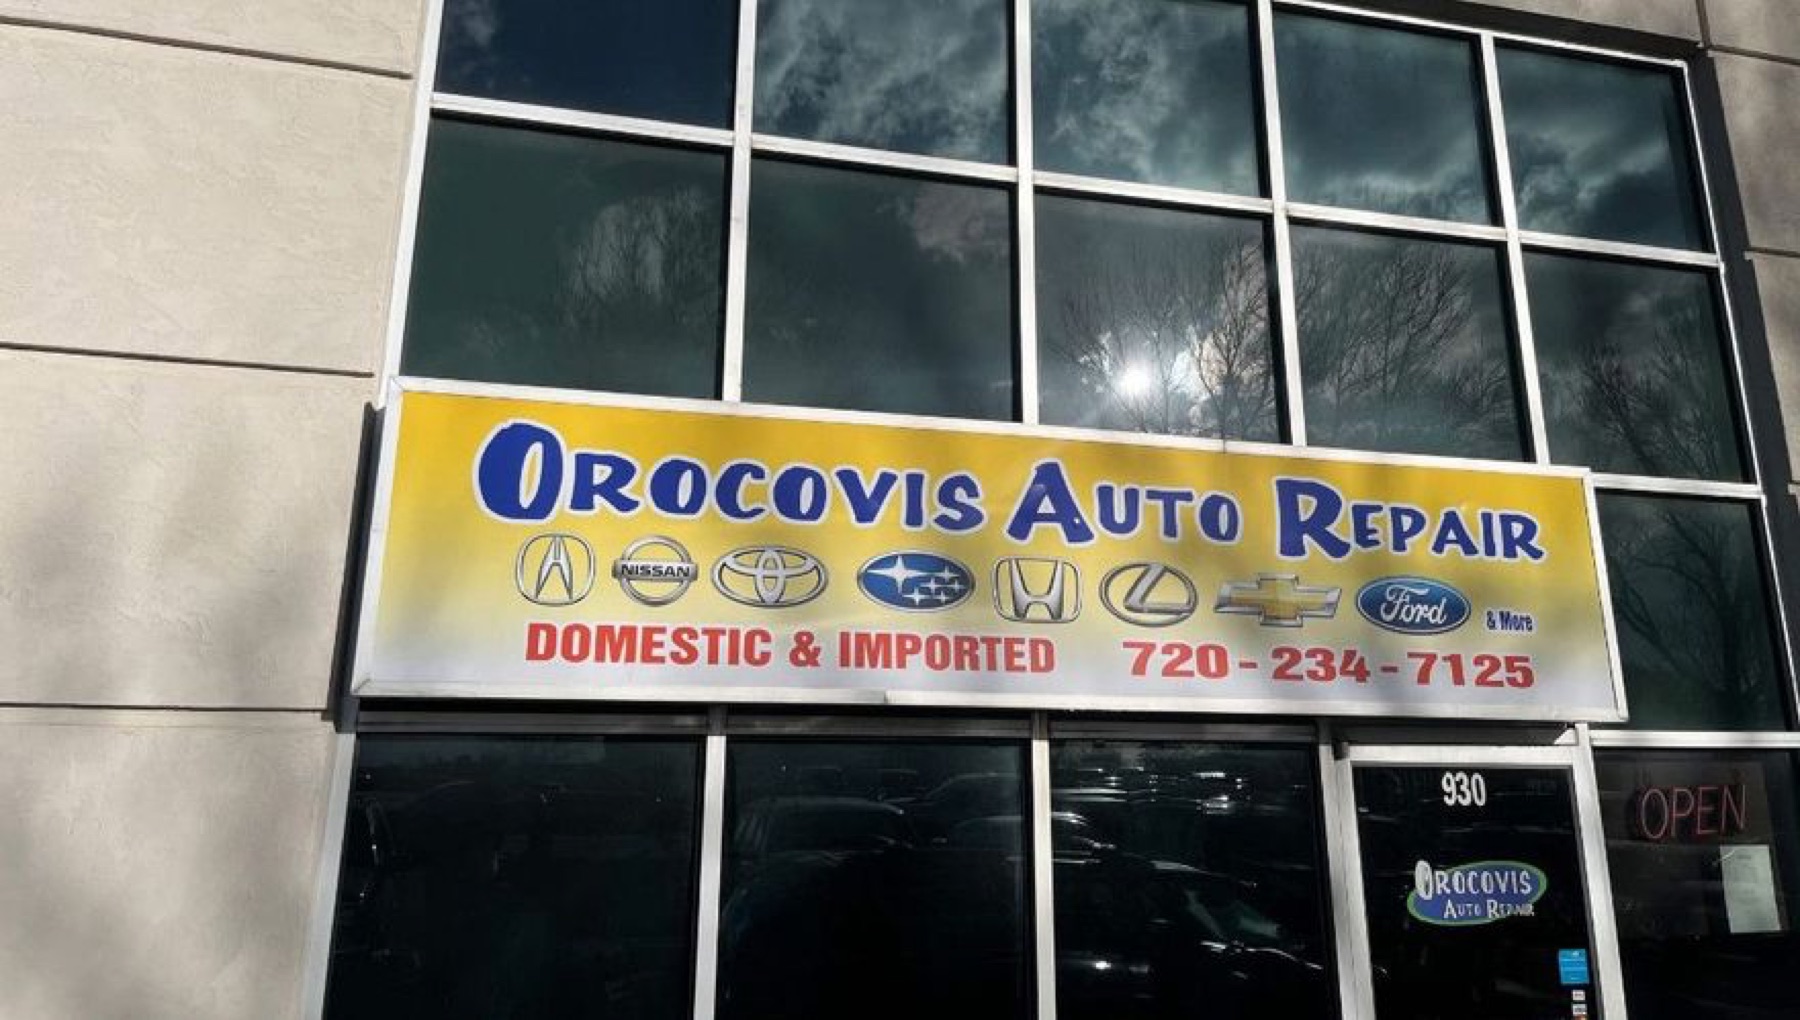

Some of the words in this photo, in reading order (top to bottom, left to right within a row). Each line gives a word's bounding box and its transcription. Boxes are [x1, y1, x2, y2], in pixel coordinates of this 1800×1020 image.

[475, 420, 984, 533] OROCOVIS
[1006, 462, 1241, 544] AUTO
[1275, 478, 1545, 561] REPAIR
[619, 563, 691, 579] NISSAN
[1380, 585, 1447, 624] Ford
[1500, 611, 1533, 632] More
[525, 622, 772, 668] DOMESTIC
[788, 630, 821, 668] &
[838, 631, 1056, 675] IMPORTED
[1441, 771, 1486, 806] 930
[1640, 784, 1746, 840] OPEN
[1415, 860, 1532, 900] OROCOVIS
